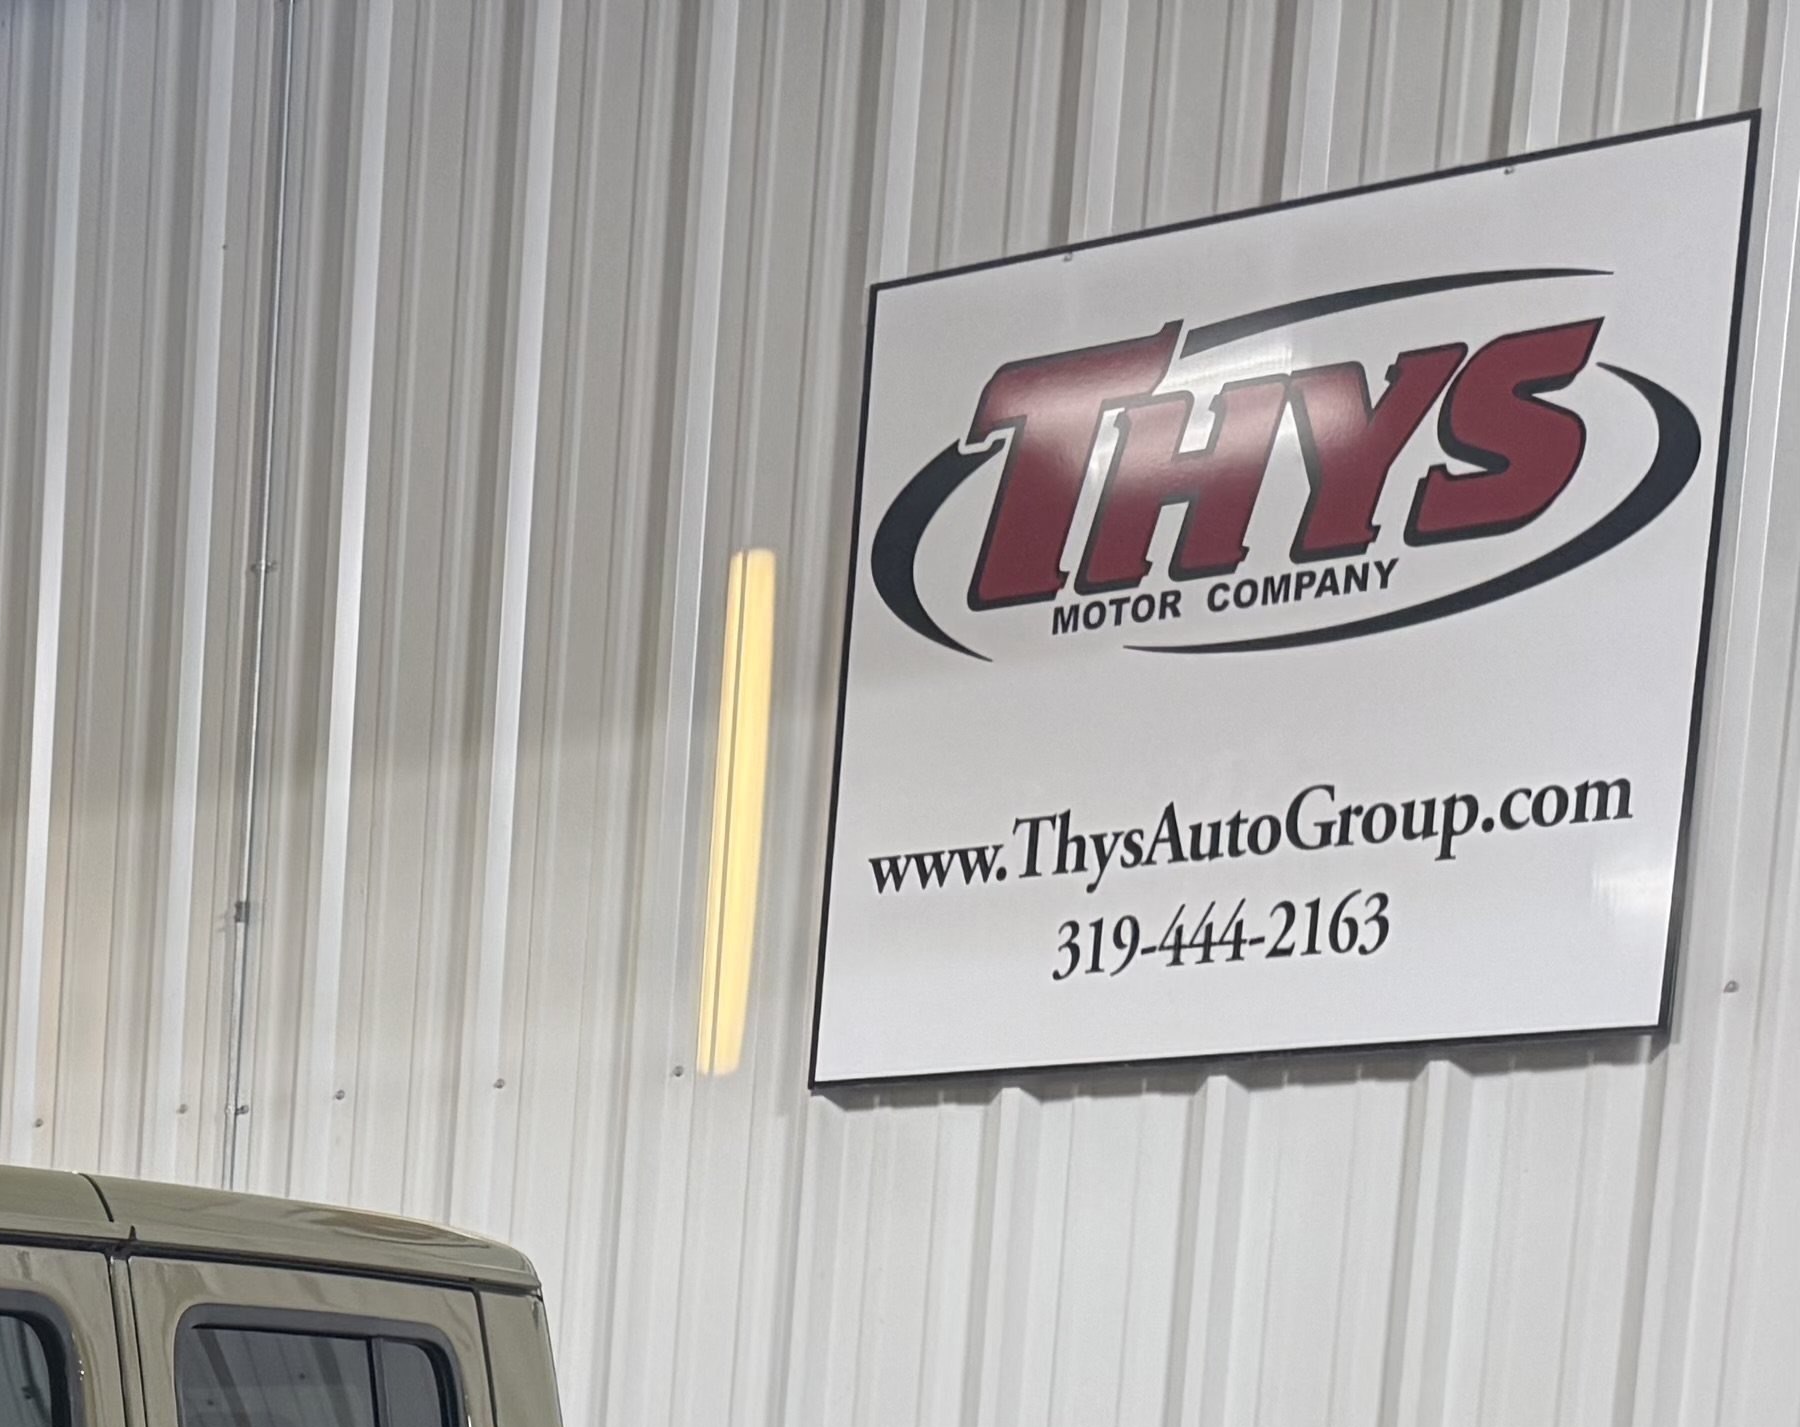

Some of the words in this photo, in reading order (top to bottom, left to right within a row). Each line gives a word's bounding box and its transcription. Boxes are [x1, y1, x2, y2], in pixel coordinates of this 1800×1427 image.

[957, 315, 1606, 612] THYS
[1051, 590, 1182, 637] MOTOR
[1206, 558, 1399, 615] COMPANY
[868, 772, 1634, 894] www.ThysAutoGroup.com
[1051, 889, 1390, 981] 319-444-2163
